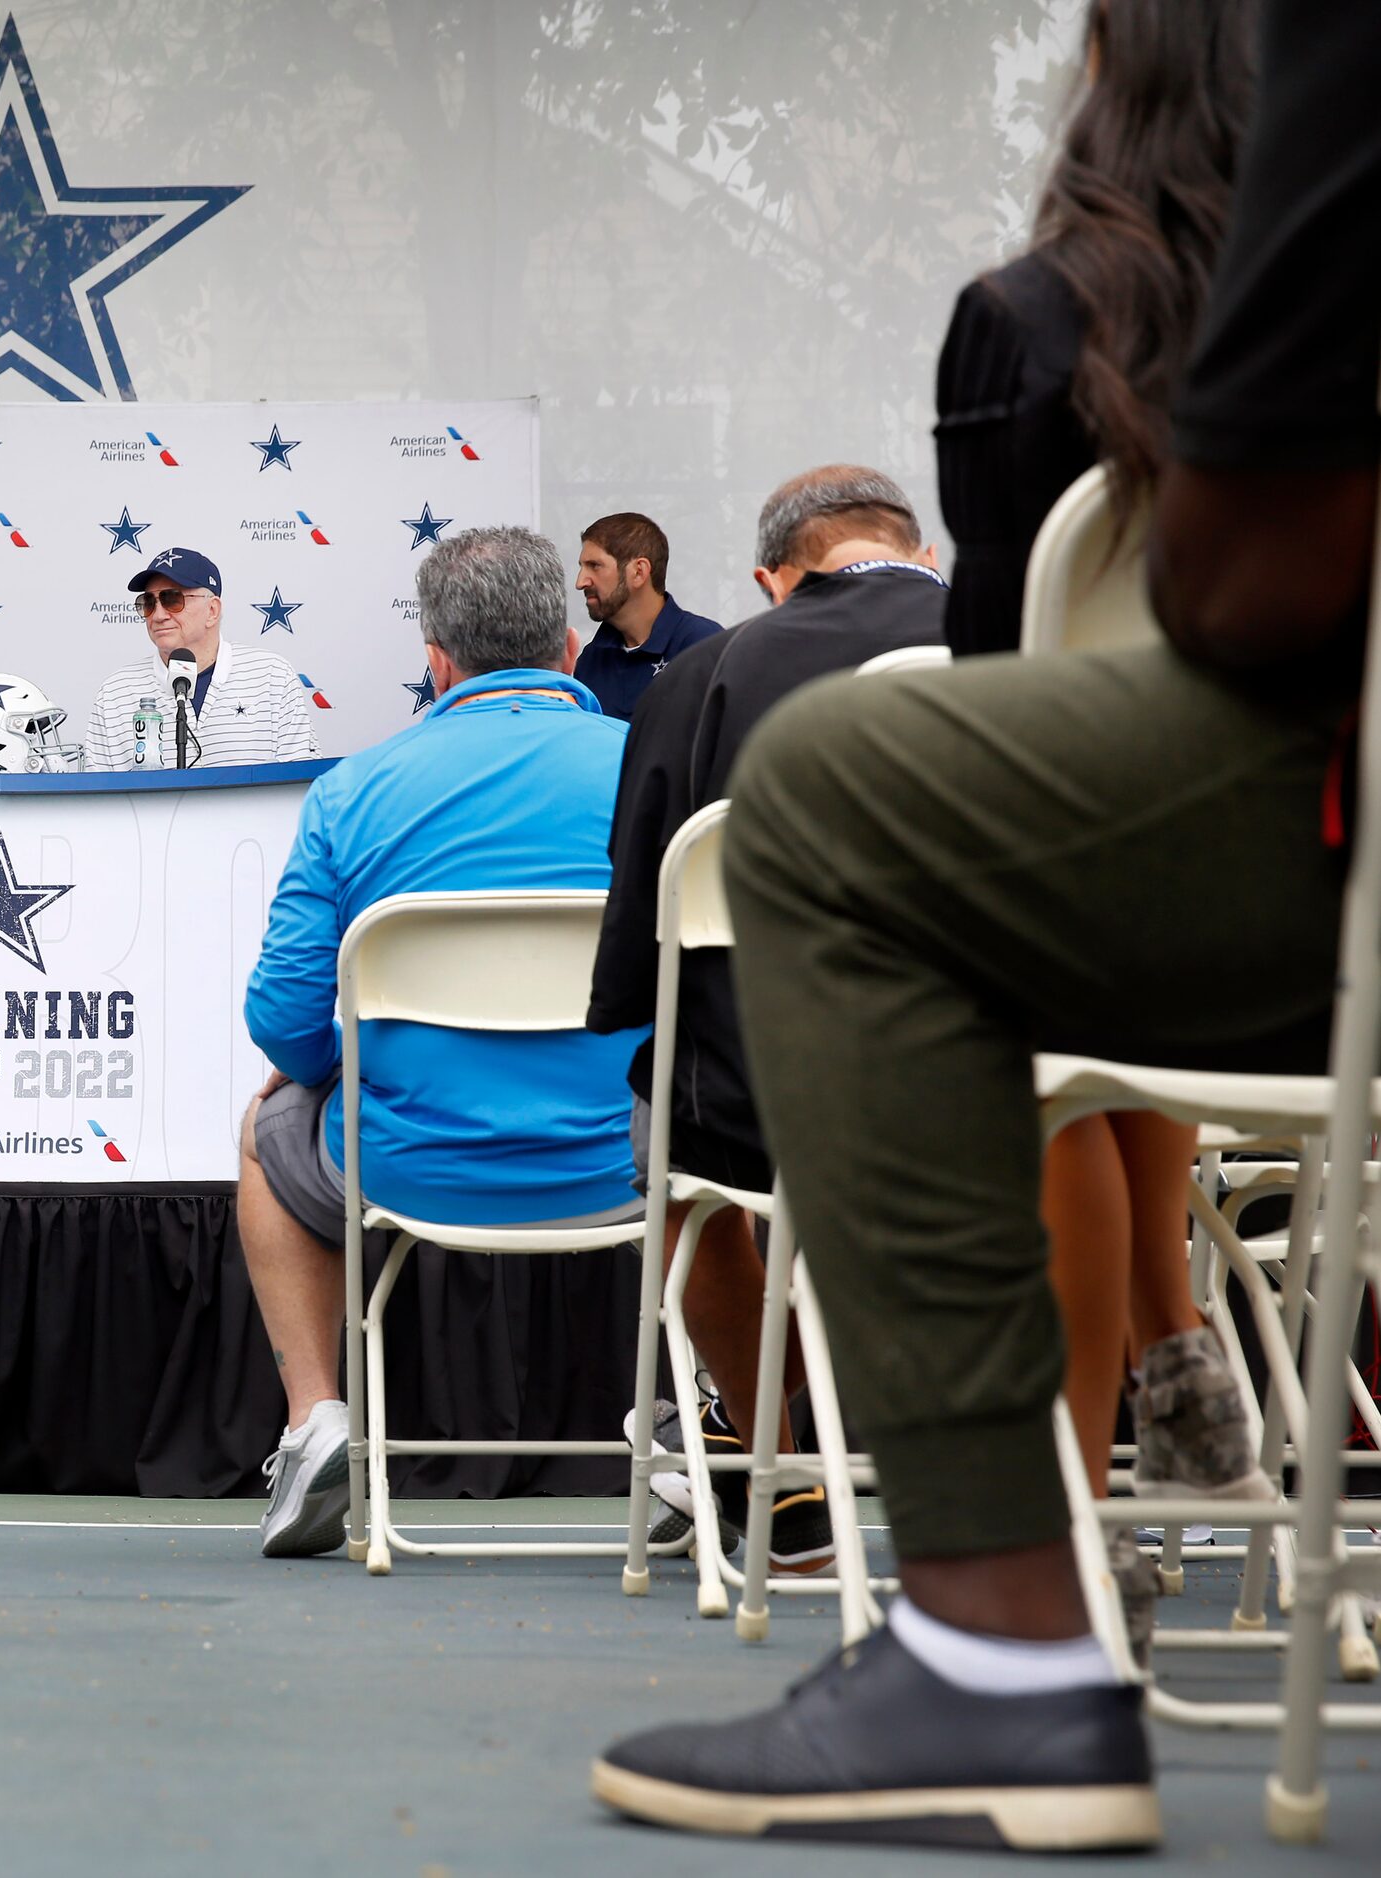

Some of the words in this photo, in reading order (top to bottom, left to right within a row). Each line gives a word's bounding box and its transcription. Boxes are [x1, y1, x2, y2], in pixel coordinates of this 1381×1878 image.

[89, 440, 146, 450] American
[390, 435, 447, 446] American
[100, 451, 146, 461] Airlines
[402, 446, 447, 457] Airlines
[240, 519, 296, 529] American
[252, 530, 296, 541] Airlines
[102, 613, 146, 624] Airlines
[134, 719, 146, 764] core
[13, 1049, 134, 1099] 2022
